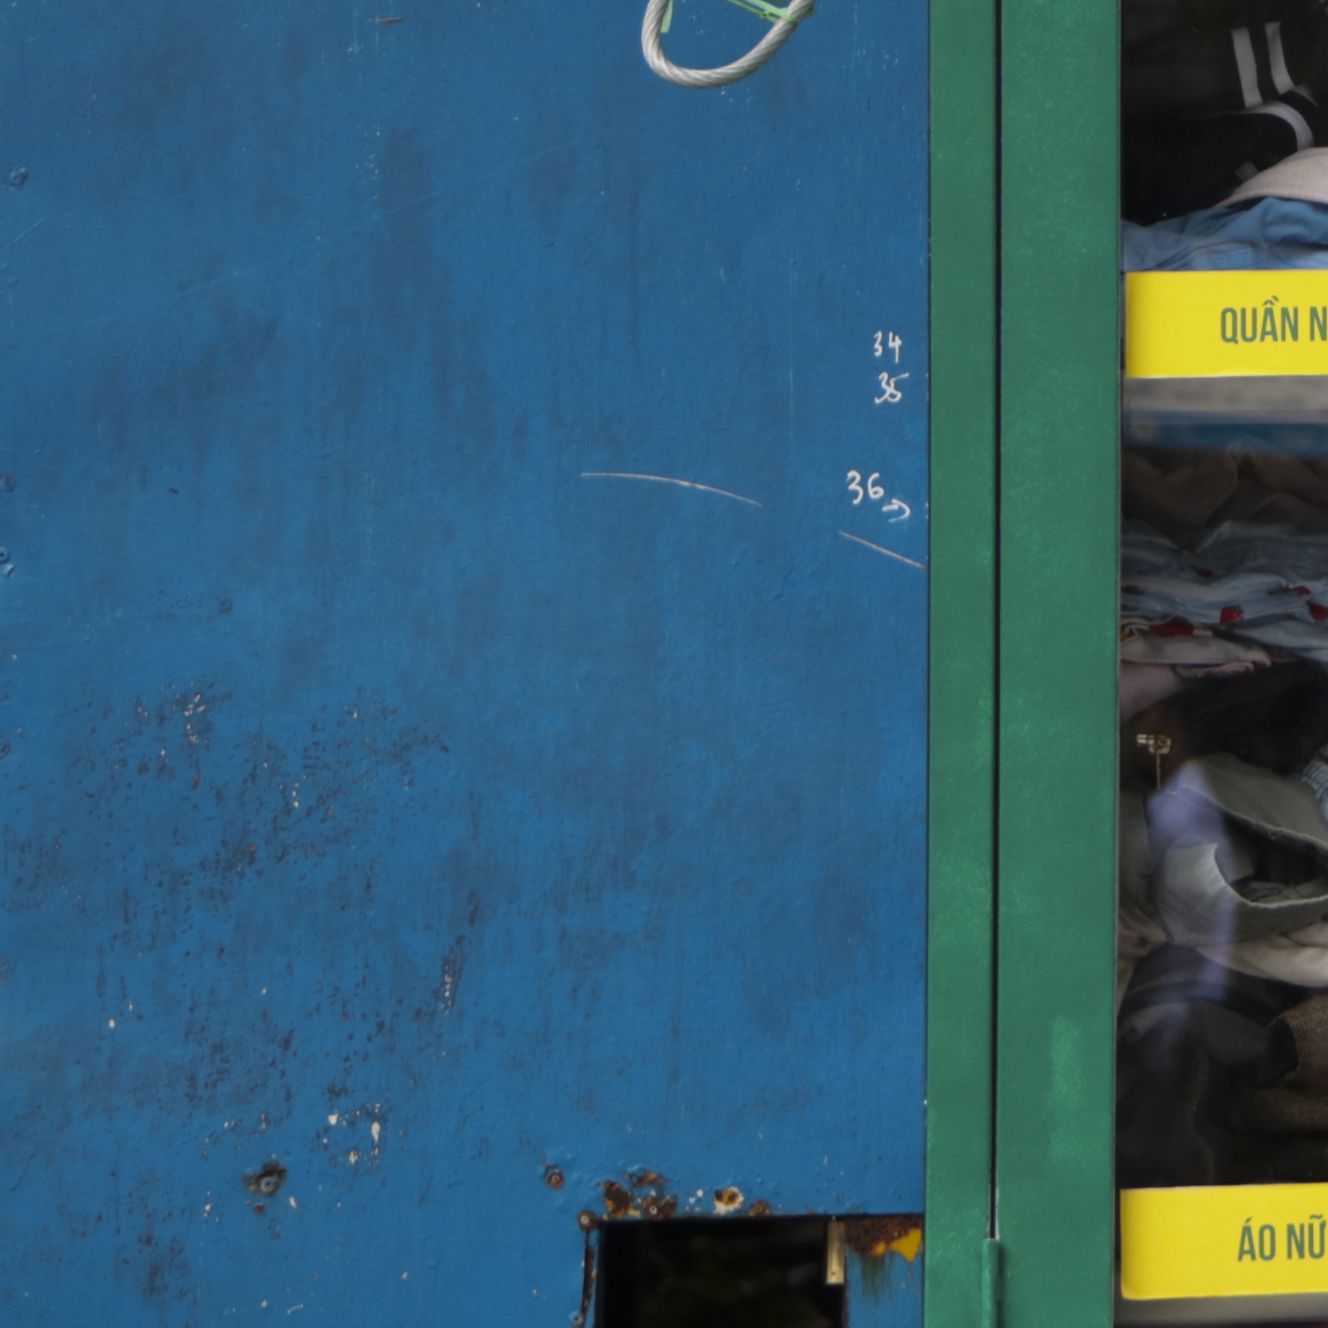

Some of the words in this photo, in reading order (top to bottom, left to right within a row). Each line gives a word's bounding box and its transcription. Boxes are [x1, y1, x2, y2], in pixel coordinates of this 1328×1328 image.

[1219, 295, 1300, 345] QUẦN
[872, 330, 903, 364] 34
[873, 371, 911, 405] 35
[846, 469, 885, 506] 36
[1236, 1216, 1278, 1263] ÁO
[1285, 1212, 1328, 1261] NỮ
